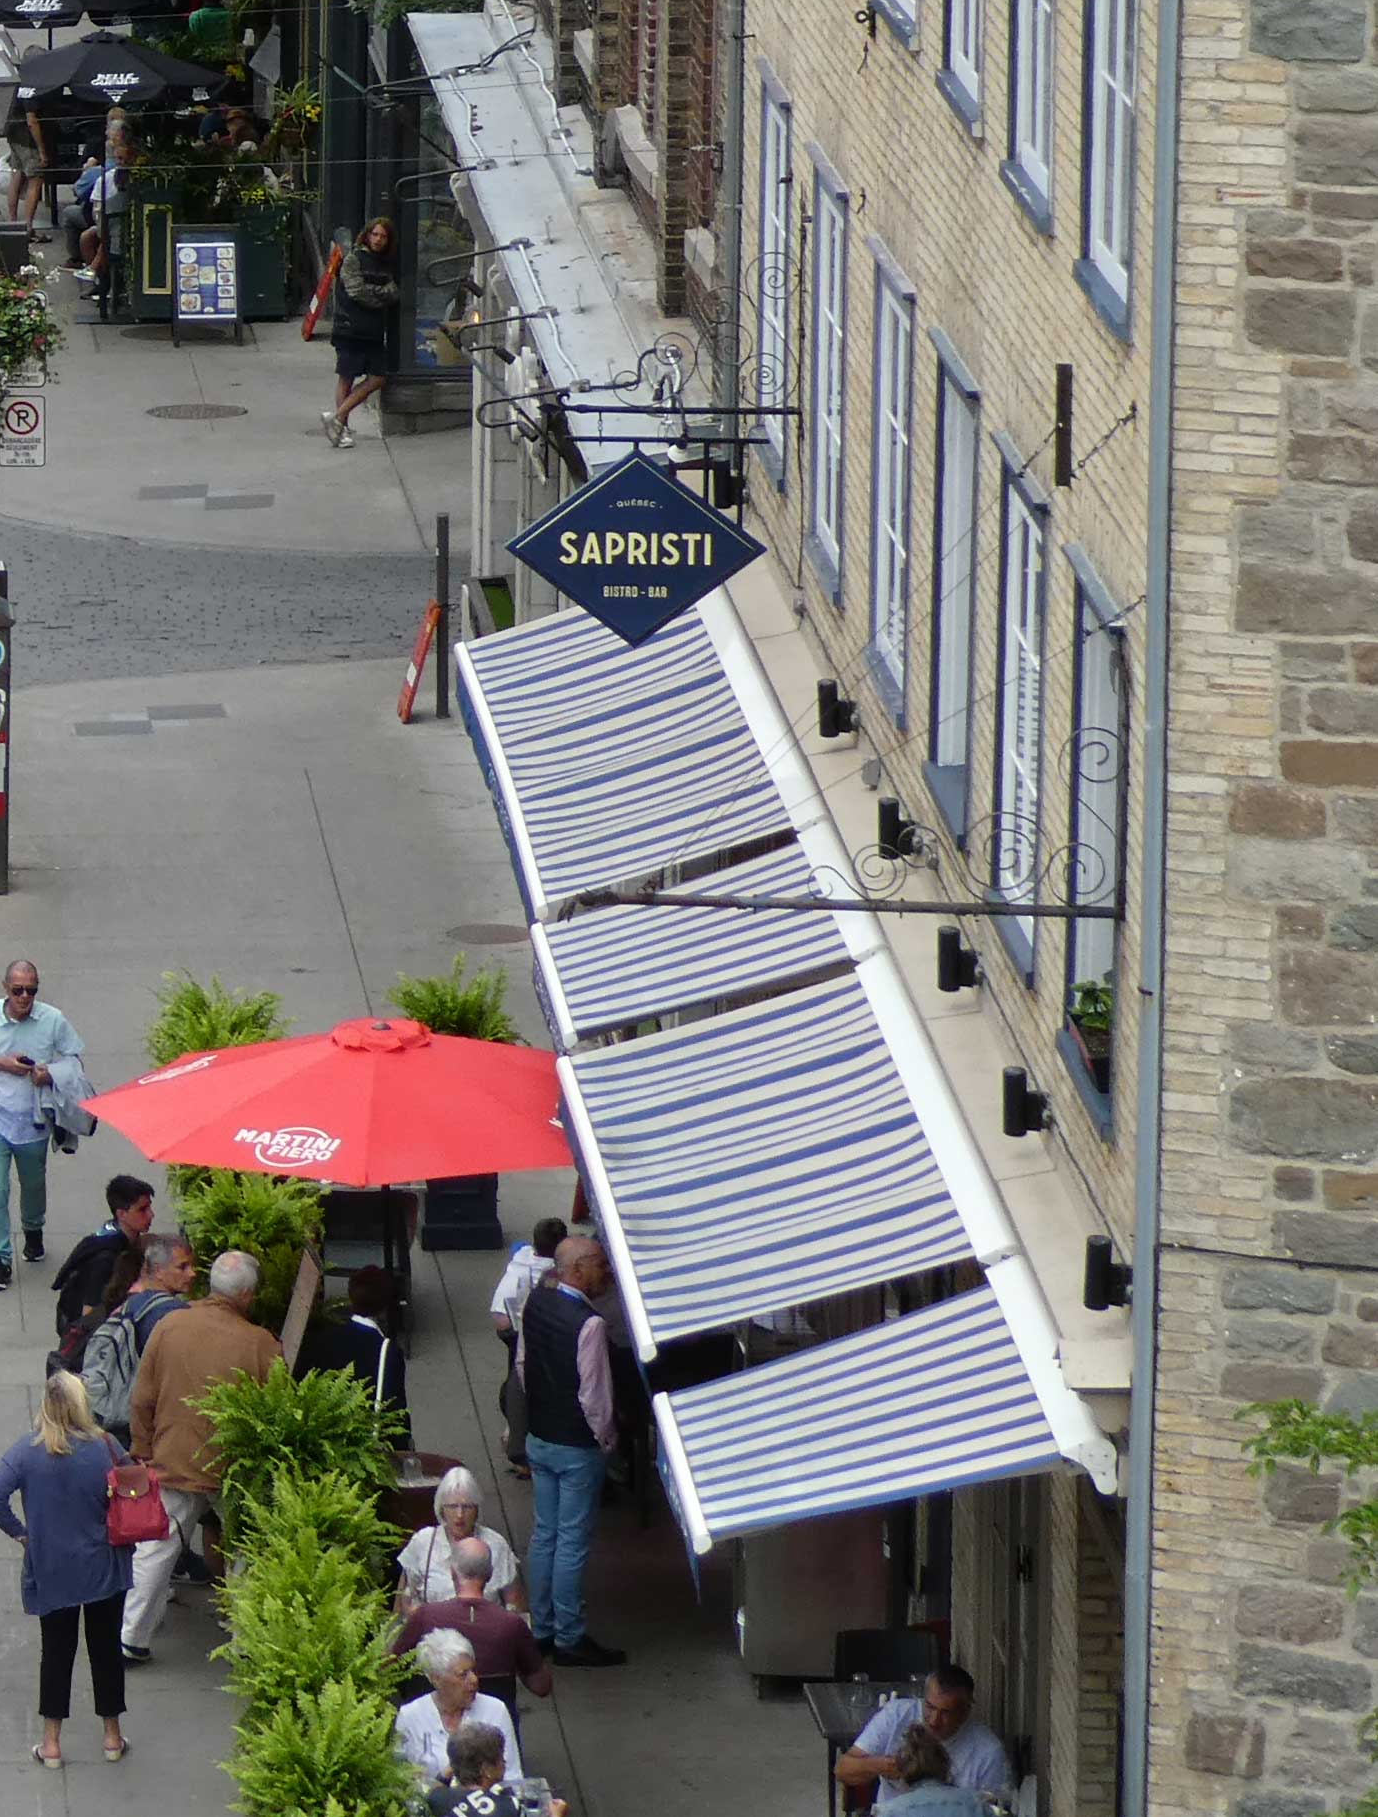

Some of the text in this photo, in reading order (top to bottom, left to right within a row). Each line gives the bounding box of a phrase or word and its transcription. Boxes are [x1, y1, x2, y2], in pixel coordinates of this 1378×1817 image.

[616, 497, 657, 508] QUÉBEC
[559, 531, 712, 566] SAPRISTI
[603, 585, 639, 598] BISTRO
[647, 585, 668, 598] BAR
[233, 1128, 342, 1152] MARTINI
[266, 1145, 333, 1161] FIERO
